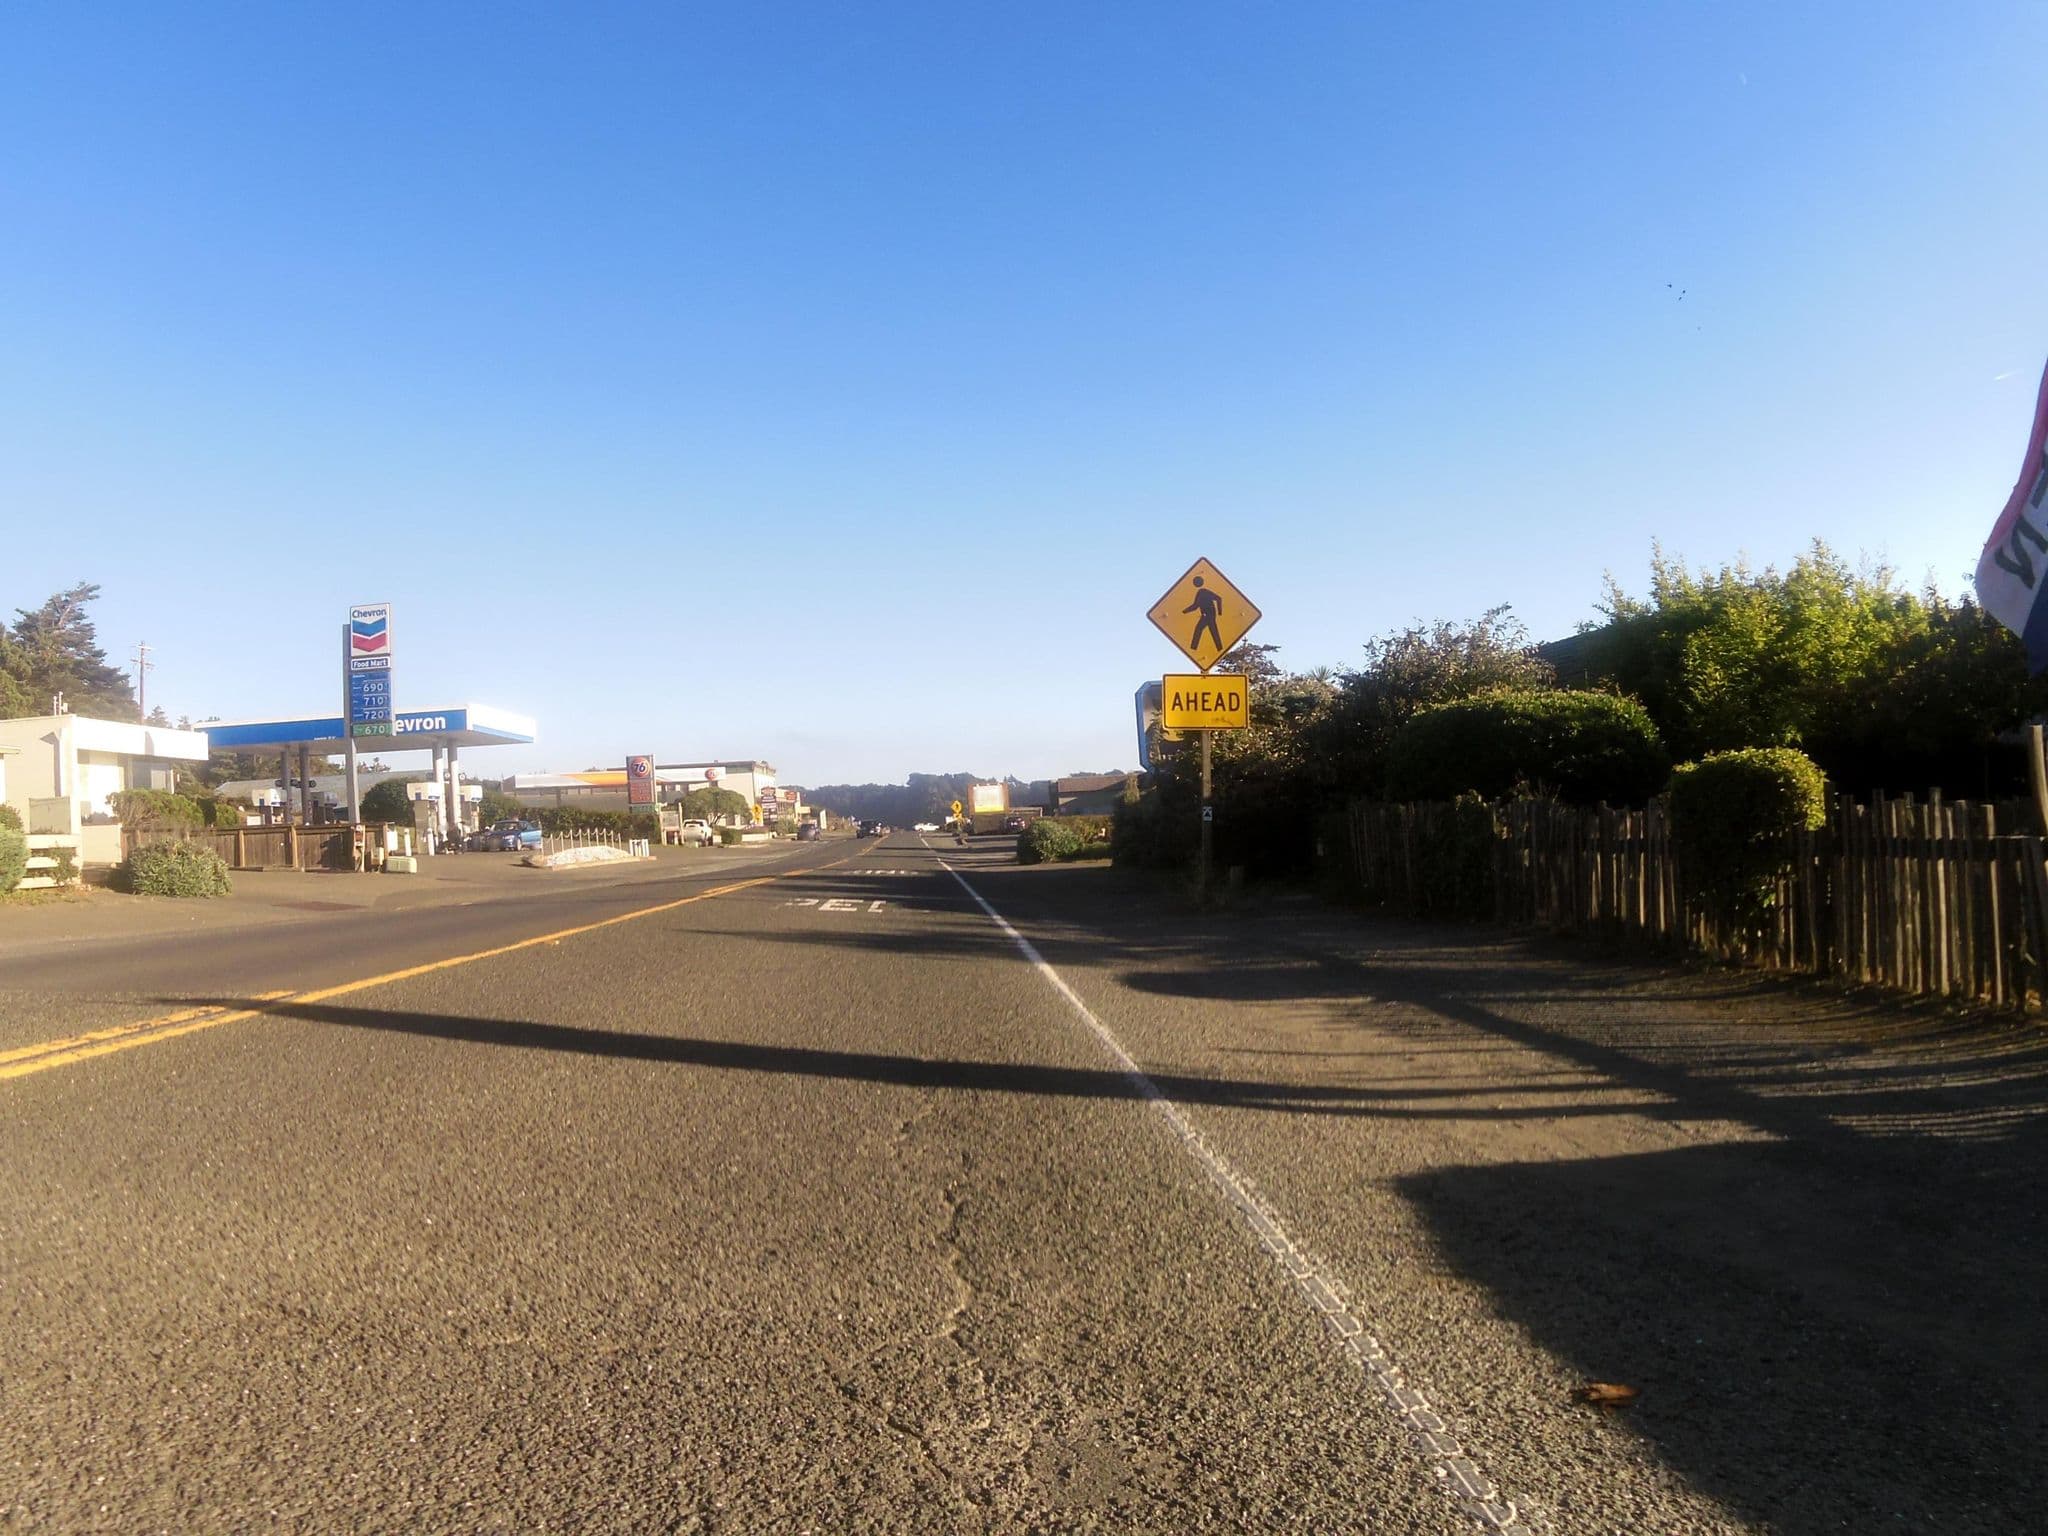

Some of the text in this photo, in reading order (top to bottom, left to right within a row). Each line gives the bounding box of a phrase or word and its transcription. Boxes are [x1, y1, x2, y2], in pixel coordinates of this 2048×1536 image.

[352, 609, 387, 618] Chevron
[353, 659, 387, 668] Food Mart
[363, 683, 384, 692] 690
[363, 696, 384, 706] 710
[1171, 692, 1240, 711] AHEAD
[363, 710, 384, 720] 720
[395, 716, 446, 732] evron
[364, 725, 385, 735] 670
[633, 762, 646, 773] 76
